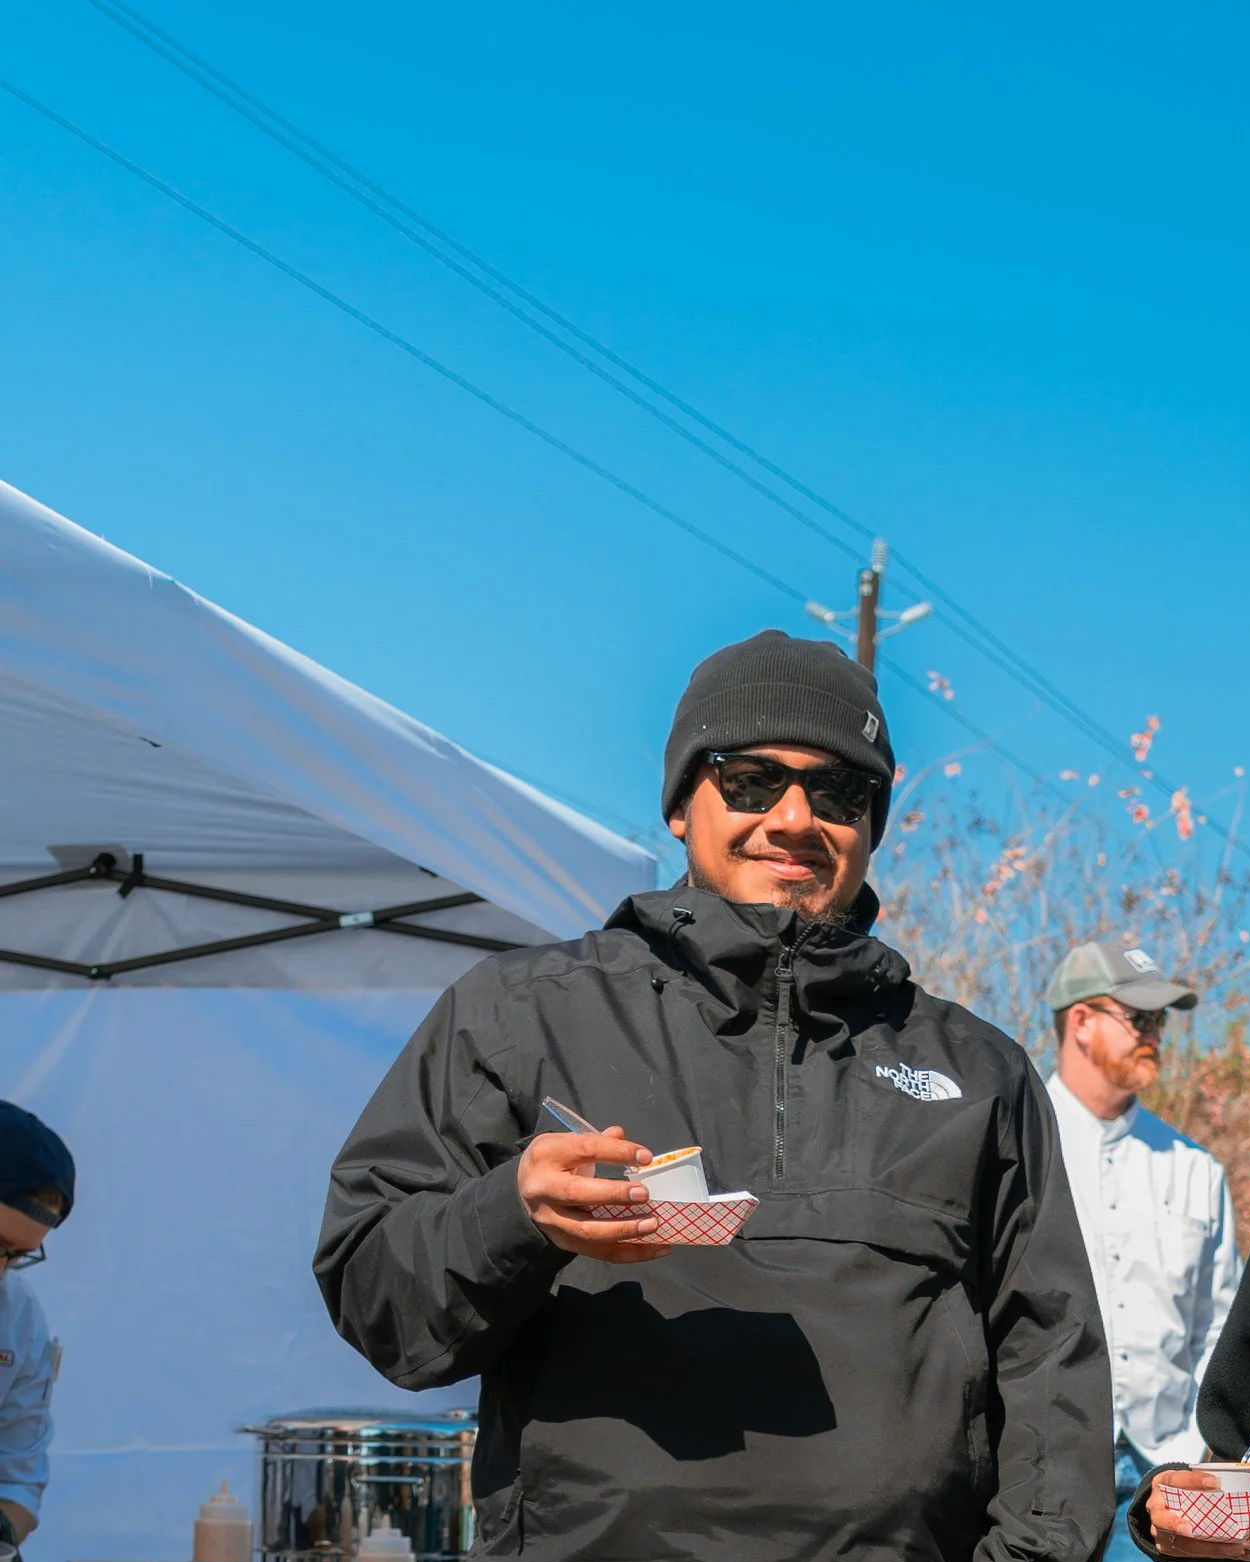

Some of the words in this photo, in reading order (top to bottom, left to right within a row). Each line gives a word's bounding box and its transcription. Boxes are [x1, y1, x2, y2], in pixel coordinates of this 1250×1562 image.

[875, 1065, 930, 1092] NORTH
[899, 1062, 930, 1081] THE
[893, 1080, 933, 1101] FACE
